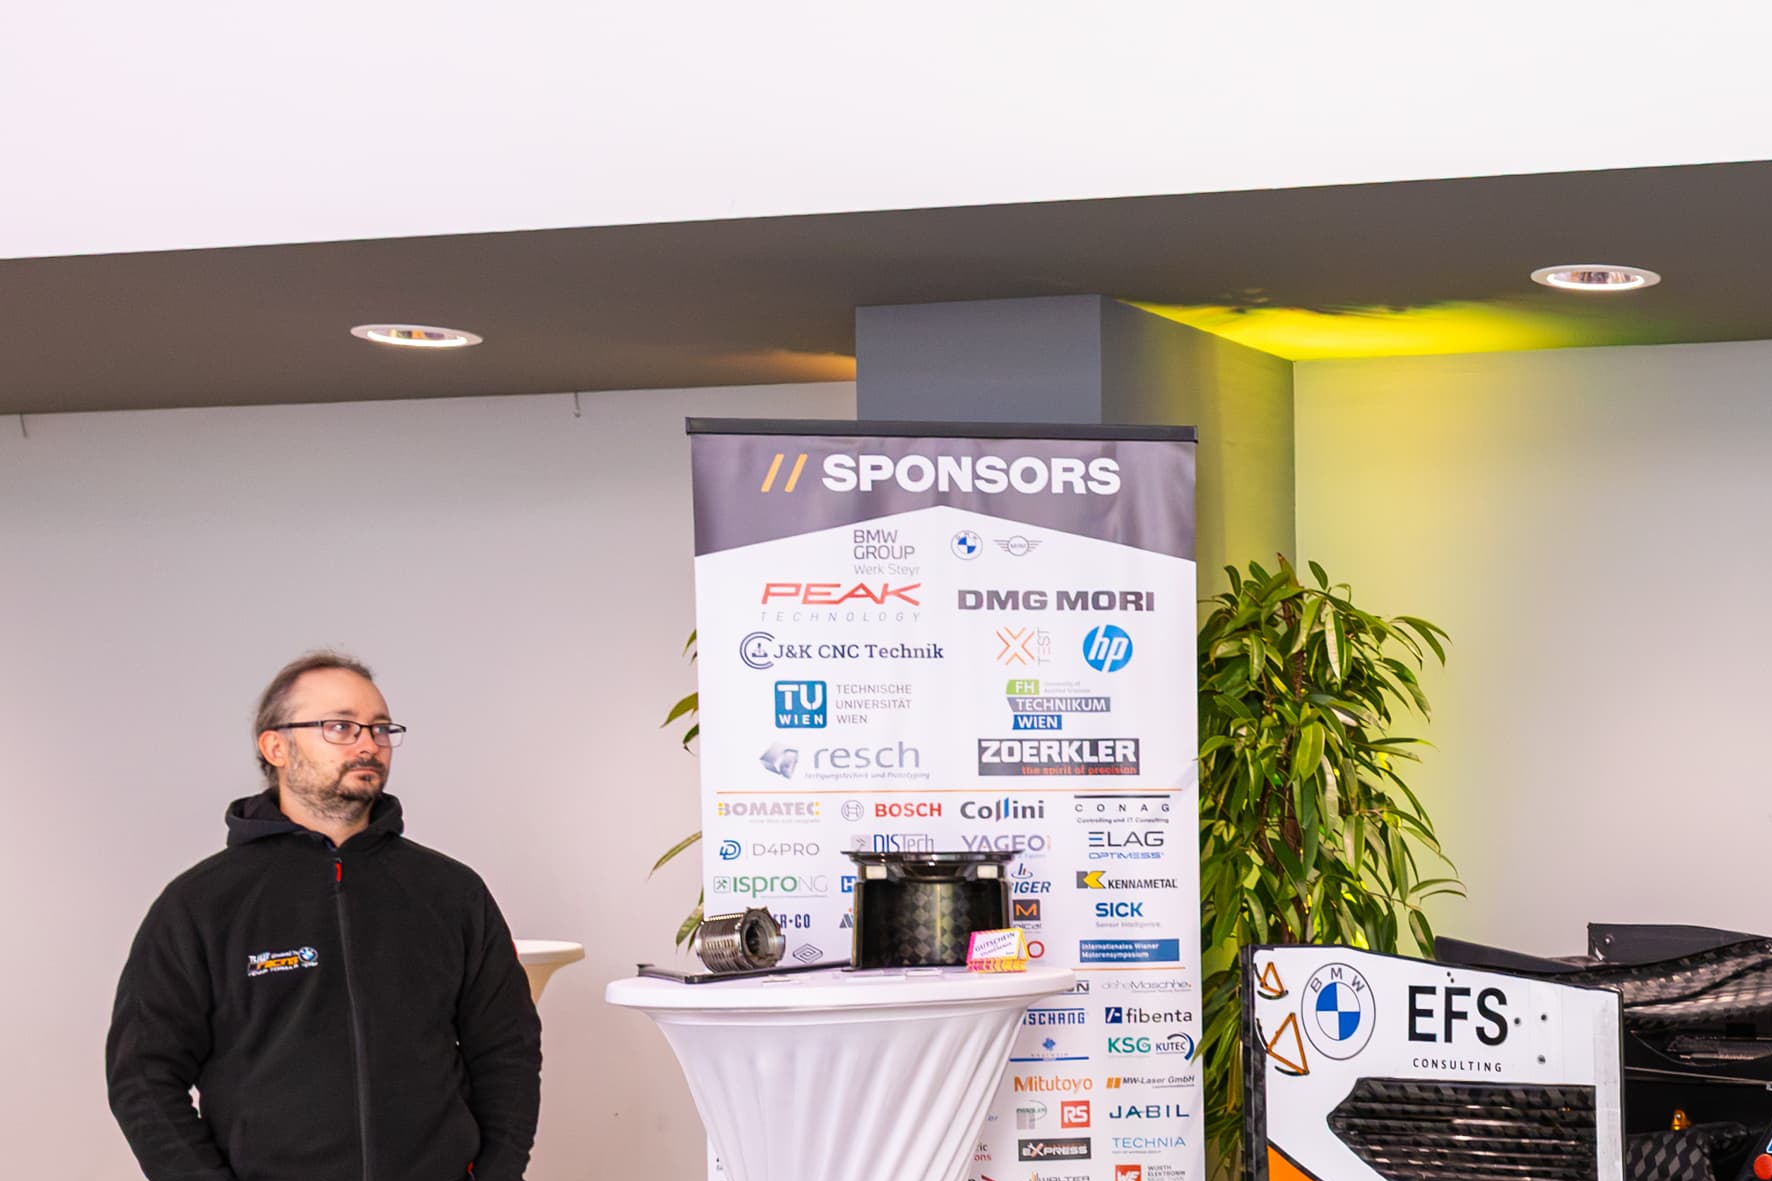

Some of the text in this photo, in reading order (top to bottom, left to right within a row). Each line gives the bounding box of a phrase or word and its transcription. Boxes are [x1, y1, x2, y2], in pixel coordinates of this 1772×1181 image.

[821, 453, 1122, 496] SPONSORS
[853, 528, 898, 545] BMW
[853, 544, 916, 561] GROUP
[853, 564, 920, 577] Werk Steyr
[761, 582, 921, 607] PEAK
[957, 589, 1155, 612] DMG MORI
[761, 611, 920, 622] TECHNOLOGY
[773, 642, 944, 661] J&K CNC Technik
[1038, 627, 1050, 665] TEST
[1088, 625, 1129, 673] hp
[836, 683, 912, 695] TECHNISCHE
[1014, 680, 1036, 693] FH
[777, 685, 823, 711] TU
[835, 697, 911, 710] UNIVERSITÄT
[1016, 698, 1107, 712] TECHNIKUM
[778, 715, 824, 726] WIEN
[836, 713, 868, 725] WIEN
[1017, 716, 1058, 729] WIEN
[814, 740, 920, 769] resch
[979, 740, 1136, 764] ZOERKLER
[1021, 765, 1136, 776] the spirit of precision
[718, 801, 821, 817] BOMATEC
[874, 802, 942, 818] BOSCH
[960, 797, 1044, 822] Collini
[961, 834, 1045, 853] YAGEO
[1088, 831, 1164, 848] ELAG
[752, 842, 820, 857] D4PRO
[1107, 879, 1177, 889] KENNAMETAL
[1095, 902, 1143, 918] SICK
[1081, 941, 1159, 951] Internationales Wiener
[1081, 950, 1149, 959] Motorensymposium
[1310, 966, 1366, 995] BMW
[1126, 1007, 1193, 1024] fibenta
[1407, 984, 1509, 1047] EFS
[1107, 1037, 1151, 1054] KSG
[1156, 1041, 1186, 1052] KUTEC
[1412, 1057, 1503, 1073] CONSULTING
[1014, 1075, 1093, 1094] Mitutoyo
[1122, 1074, 1195, 1085] MW-Laser GmbH
[1063, 1105, 1088, 1124] RS
[1109, 1104, 1190, 1119] JABIL
[1112, 1136, 1186, 1149] TECHNIA
